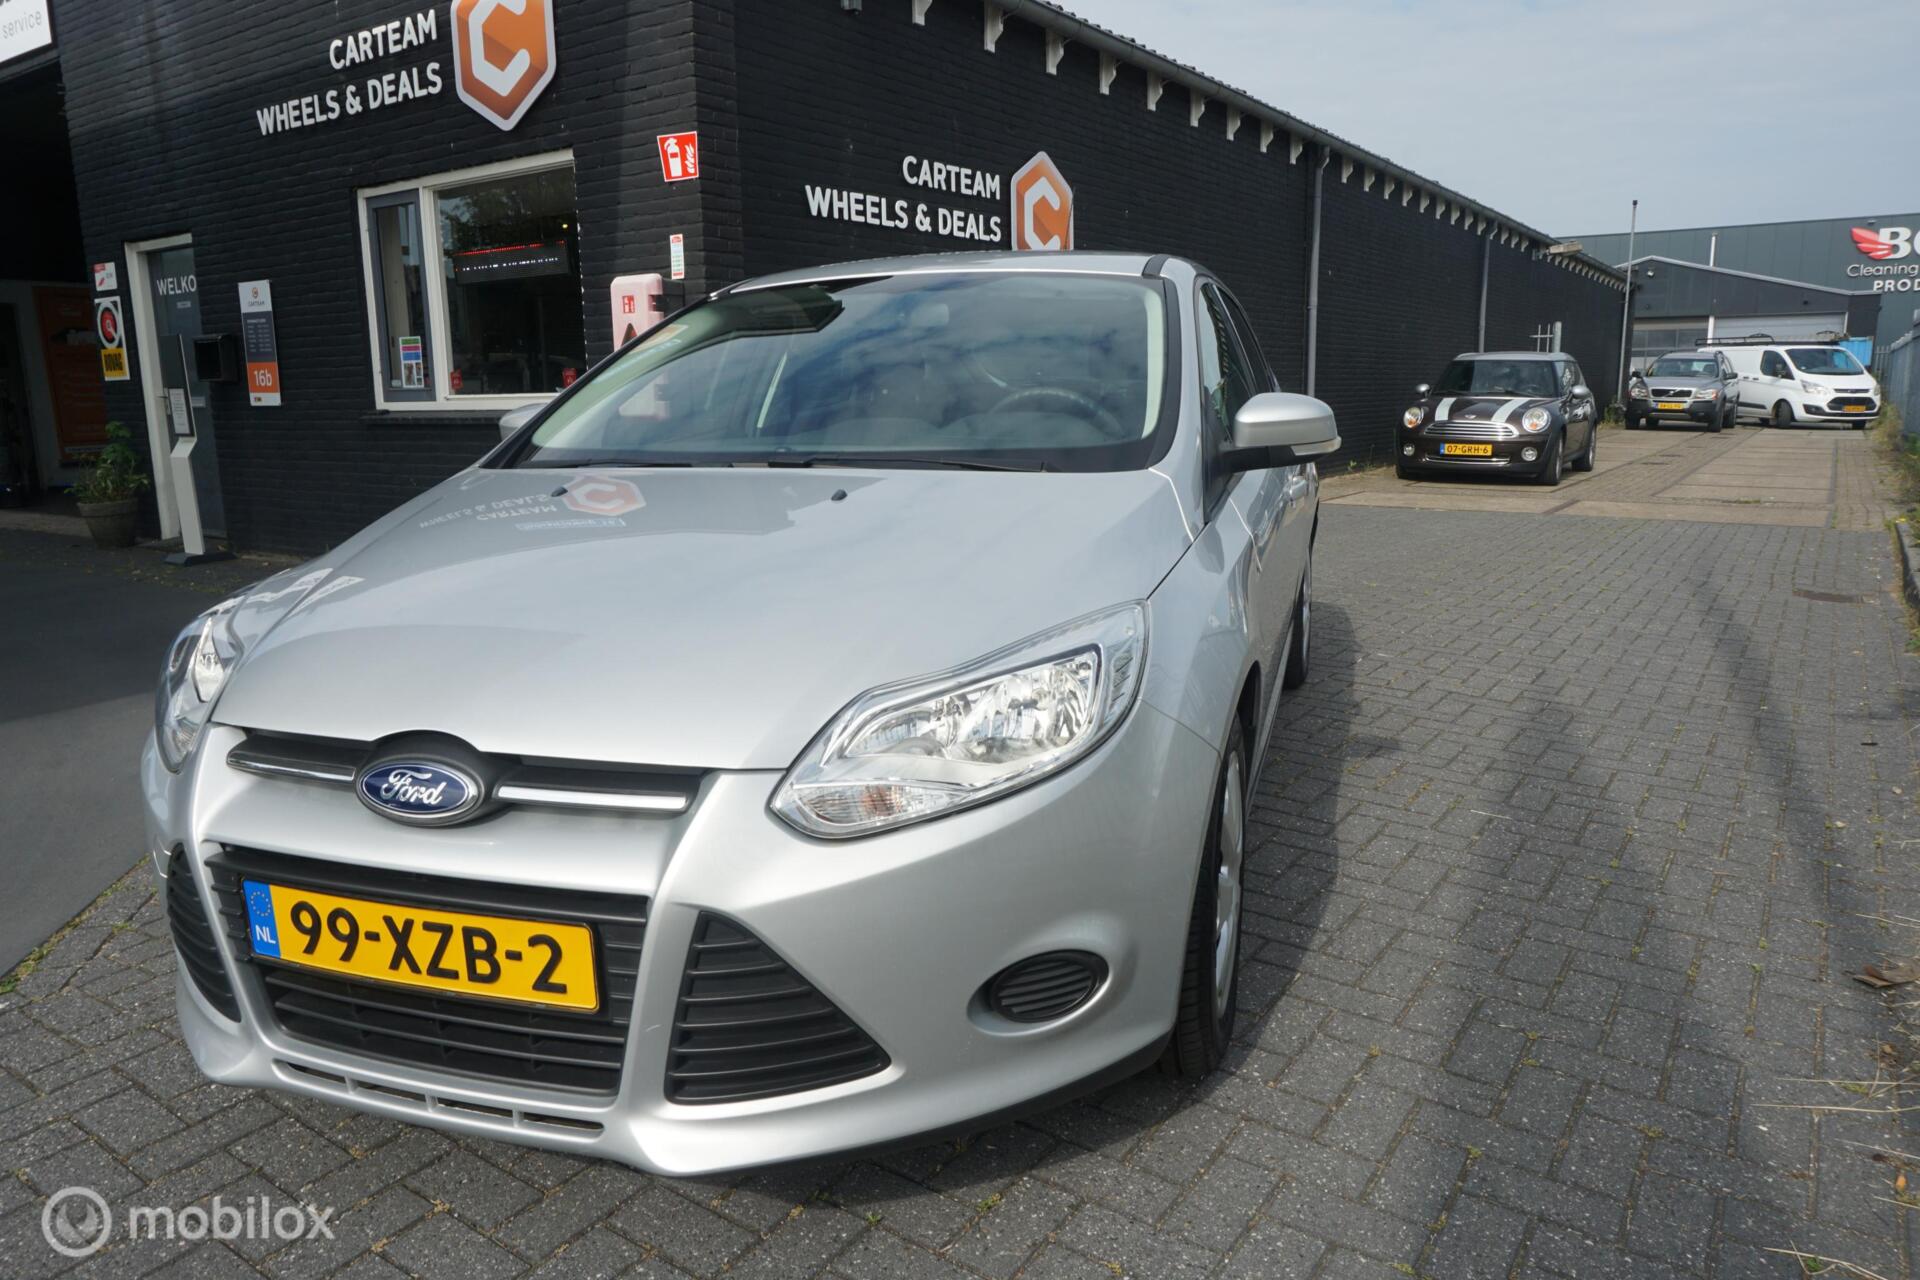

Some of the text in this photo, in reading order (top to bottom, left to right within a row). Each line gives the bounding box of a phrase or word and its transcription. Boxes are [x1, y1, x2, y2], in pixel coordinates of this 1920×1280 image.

[2, 11, 42, 39] service
[329, 9, 438, 70] CARTEAM
[256, 62, 443, 136] WHEELS & DEALS
[903, 155, 1001, 200] CARTEAM
[804, 184, 1002, 242] WHEELS & DEALS
[156, 274, 197, 296] WELKO
[1847, 262, 1919, 277] Cleaning
[253, 369, 273, 387] 16b
[1446, 445, 1489, 454] 07-GRH-6
[380, 769, 447, 805] Ford
[255, 924, 277, 944] NL
[290, 900, 568, 994] 99-XZB-2
